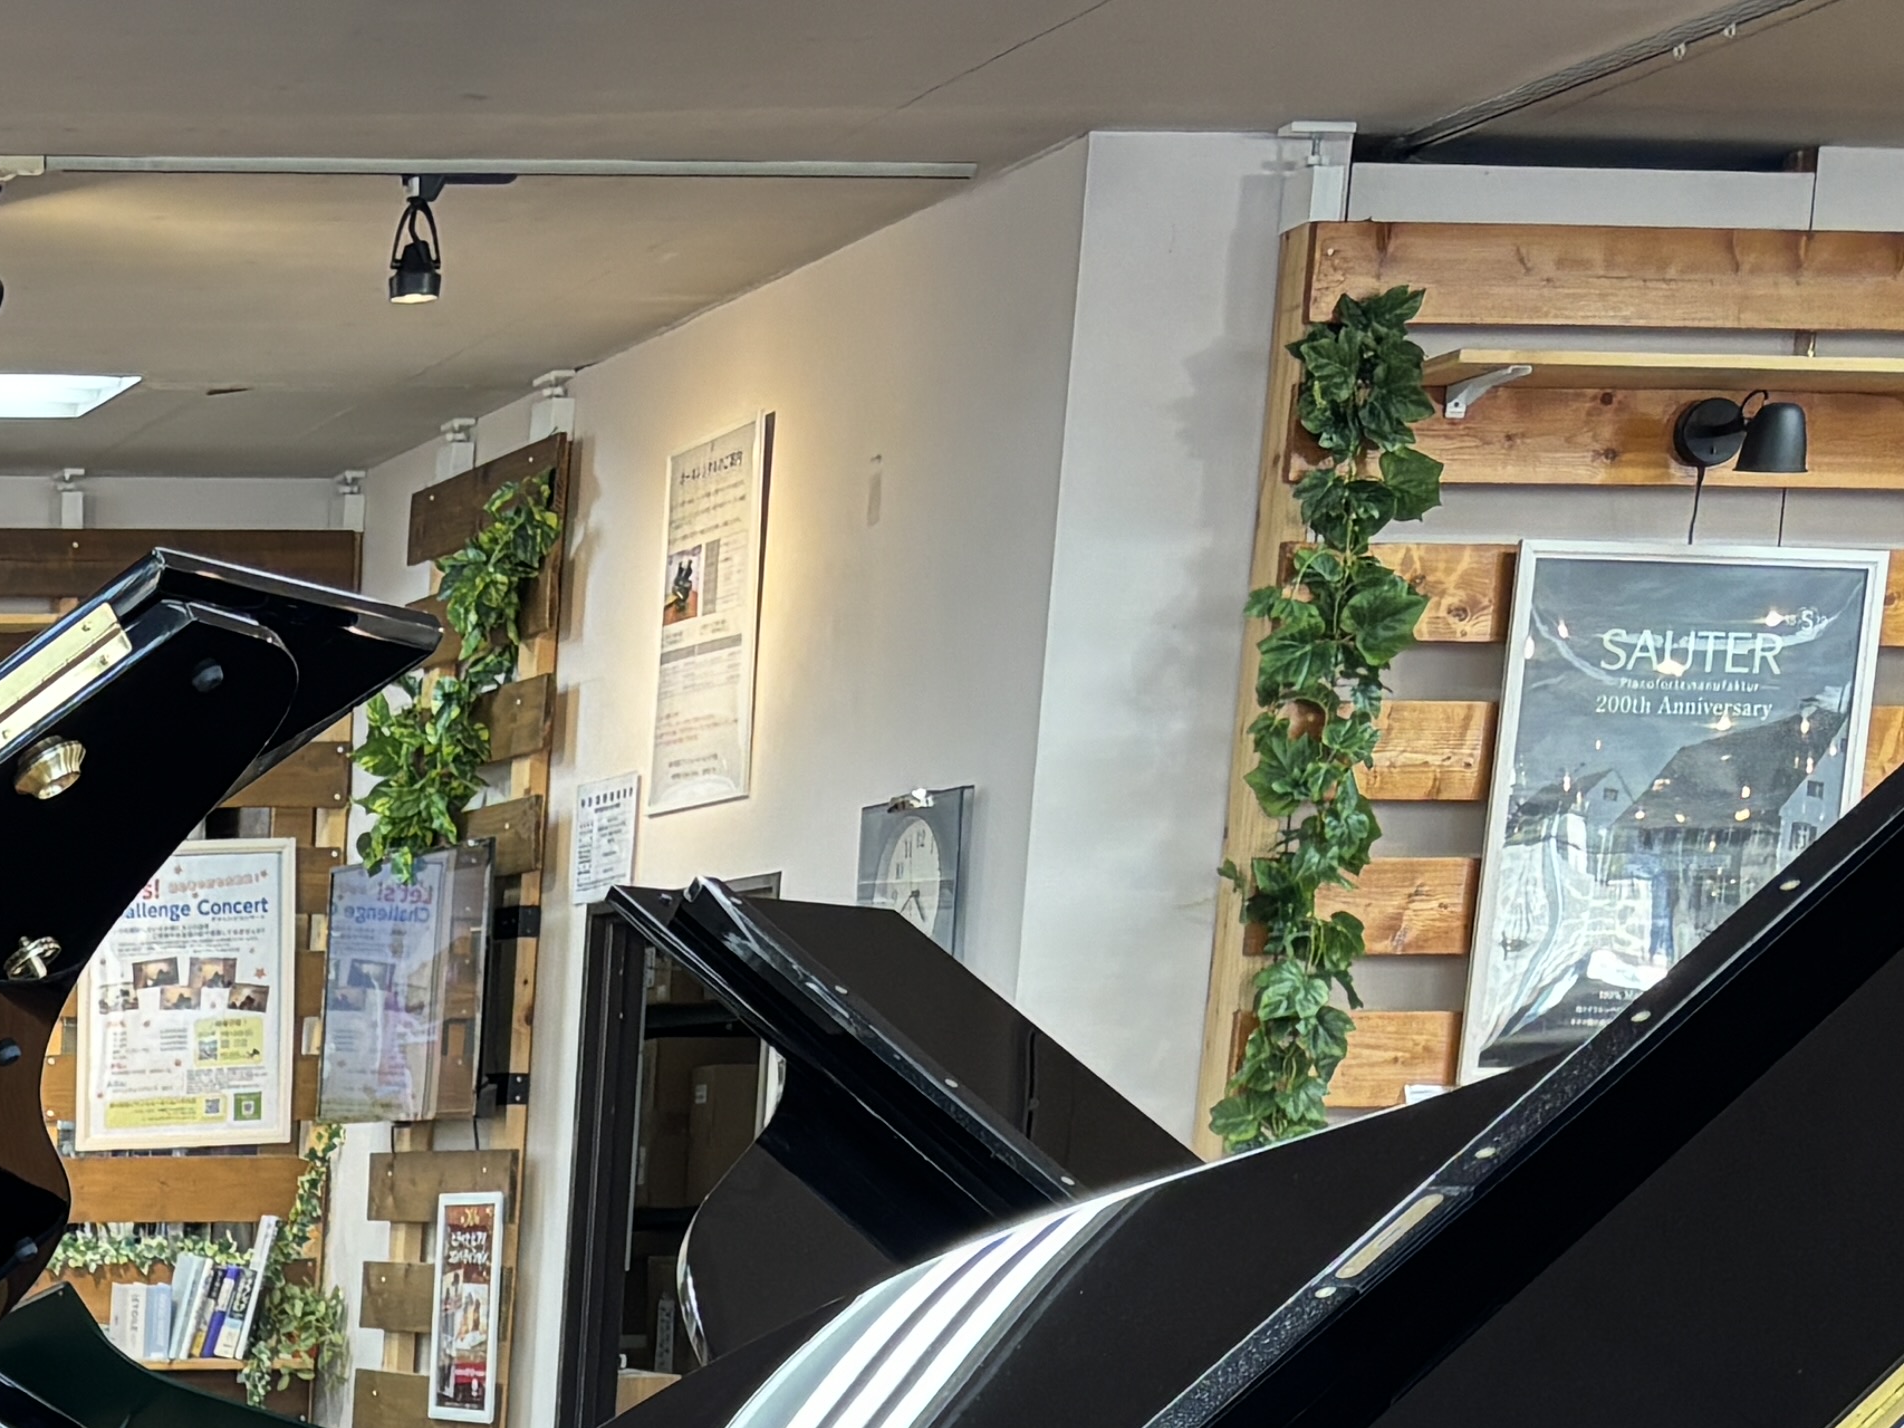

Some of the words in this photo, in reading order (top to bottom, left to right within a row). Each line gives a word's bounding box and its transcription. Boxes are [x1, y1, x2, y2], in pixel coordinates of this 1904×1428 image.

[1600, 628, 1785, 676] SAUTER
[1595, 695, 1651, 715] 200th
[1657, 696, 1773, 720] Anniversary
[125, 902, 191, 922] allenge
[197, 898, 269, 916] Concert
